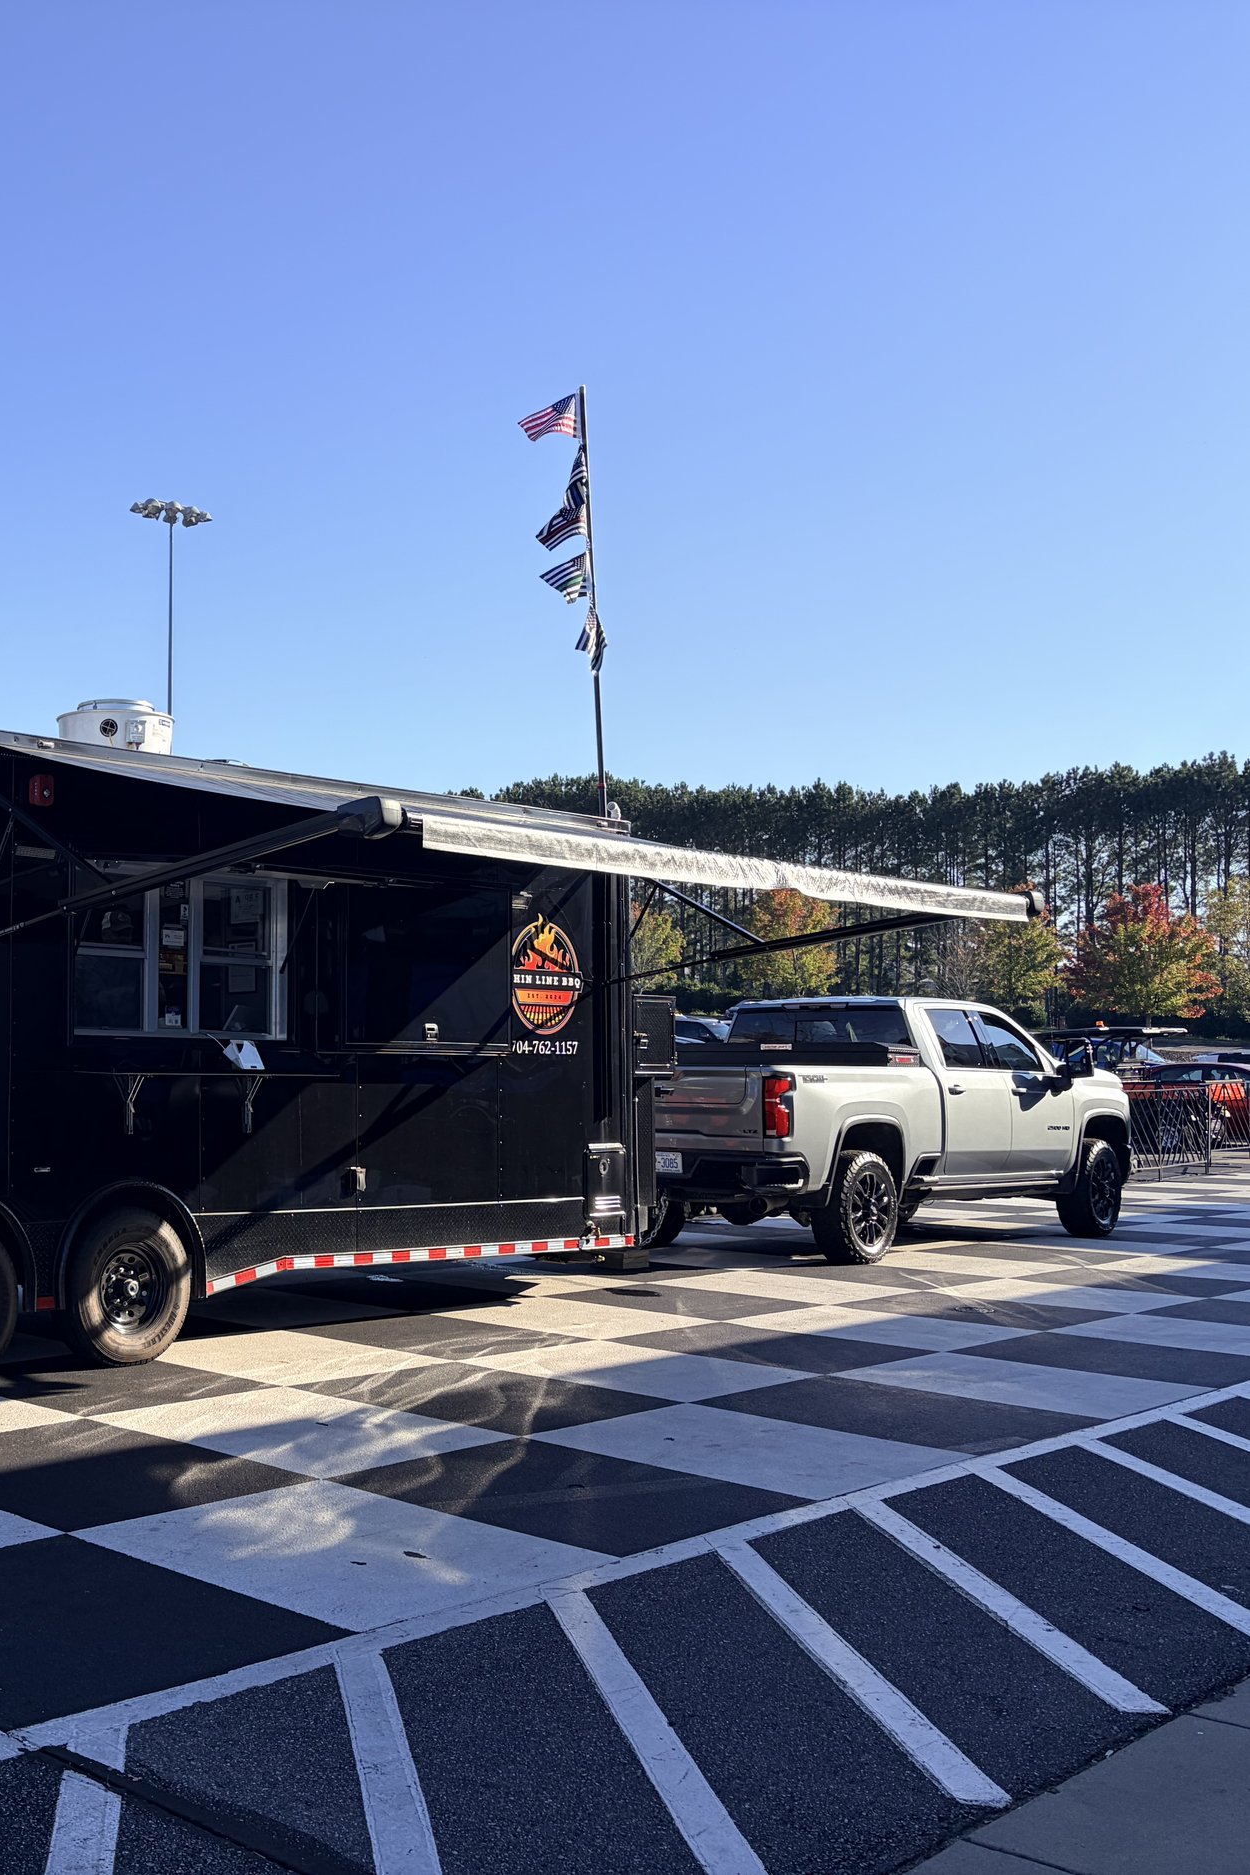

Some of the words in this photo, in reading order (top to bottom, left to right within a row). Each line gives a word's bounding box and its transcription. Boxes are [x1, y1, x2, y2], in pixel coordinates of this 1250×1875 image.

[513, 974, 533, 984] HIN
[535, 975, 559, 985] LINE
[561, 977, 581, 989] BBQ
[512, 1040, 578, 1055] 704-762-1157
